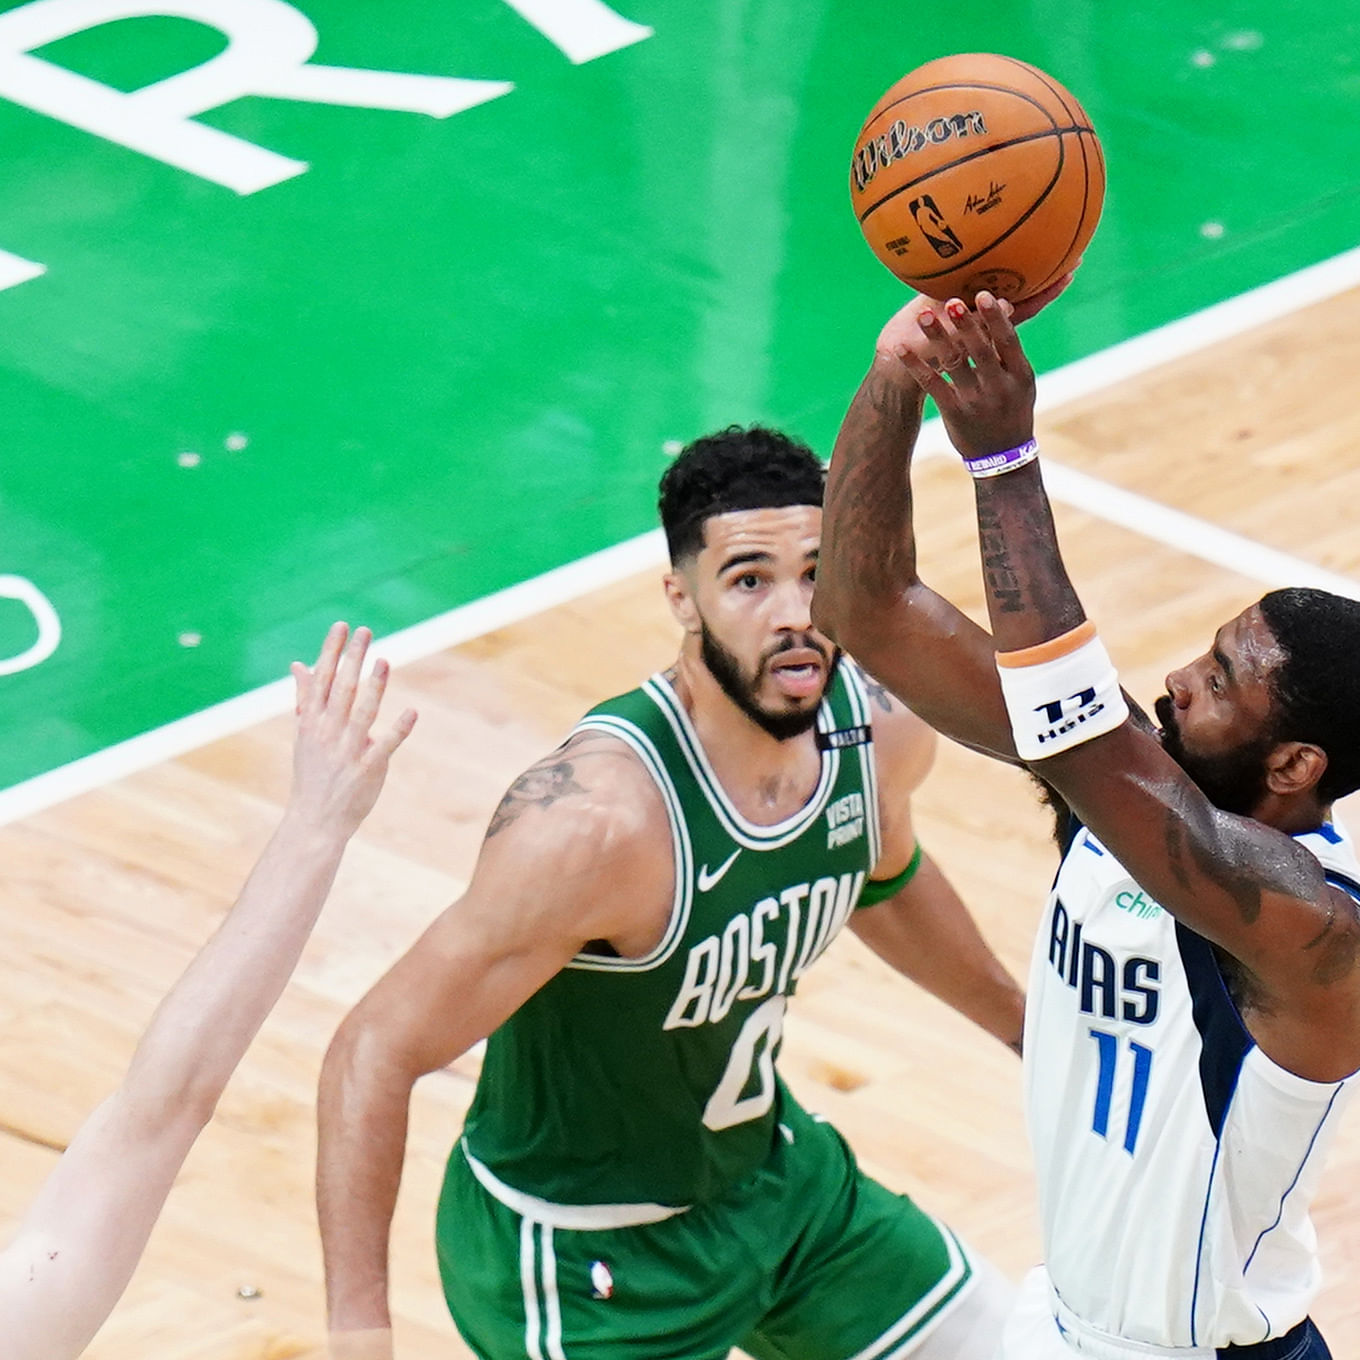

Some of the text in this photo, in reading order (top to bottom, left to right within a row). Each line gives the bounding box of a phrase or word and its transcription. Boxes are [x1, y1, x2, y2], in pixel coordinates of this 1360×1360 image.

[852, 109, 989, 193] Wilson
[662, 871, 866, 1032] BOSTON
[701, 993, 788, 1133] 0
[1089, 1028, 1155, 1159] 11
